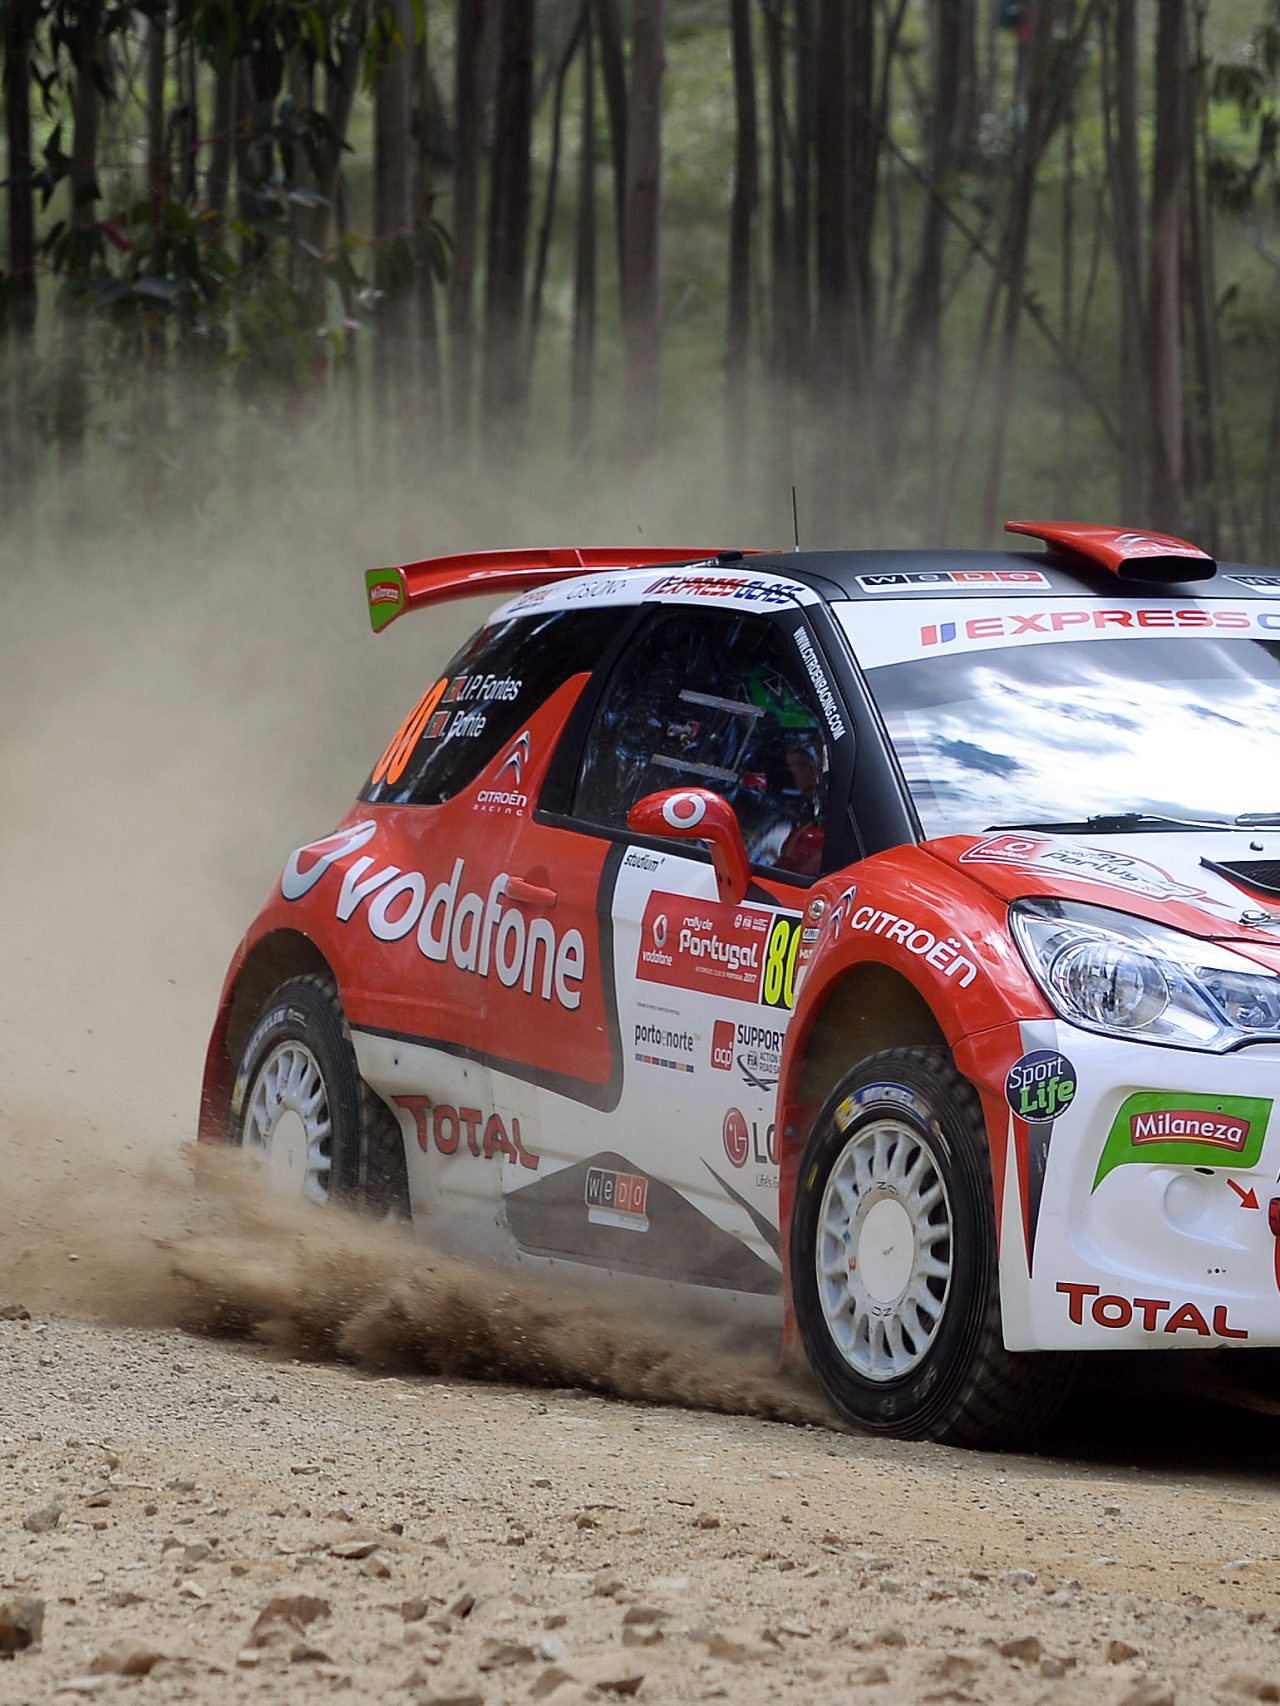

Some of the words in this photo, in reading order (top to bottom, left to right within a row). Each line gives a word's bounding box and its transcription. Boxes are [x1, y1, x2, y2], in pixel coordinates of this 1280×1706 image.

[476, 674, 522, 701] Fontes
[336, 856, 585, 1009] vodafone
[682, 916, 702, 932] rally
[701, 918, 714, 931] de
[642, 950, 673, 967] vodafone
[679, 929, 758, 970] Portugal
[1009, 1056, 1064, 1089] Sport
[1019, 1076, 1074, 1114] Life
[390, 1094, 540, 1171] TOTAL
[1134, 1111, 1243, 1144] Milaneza
[1056, 1281, 1249, 1339] TOTAL
